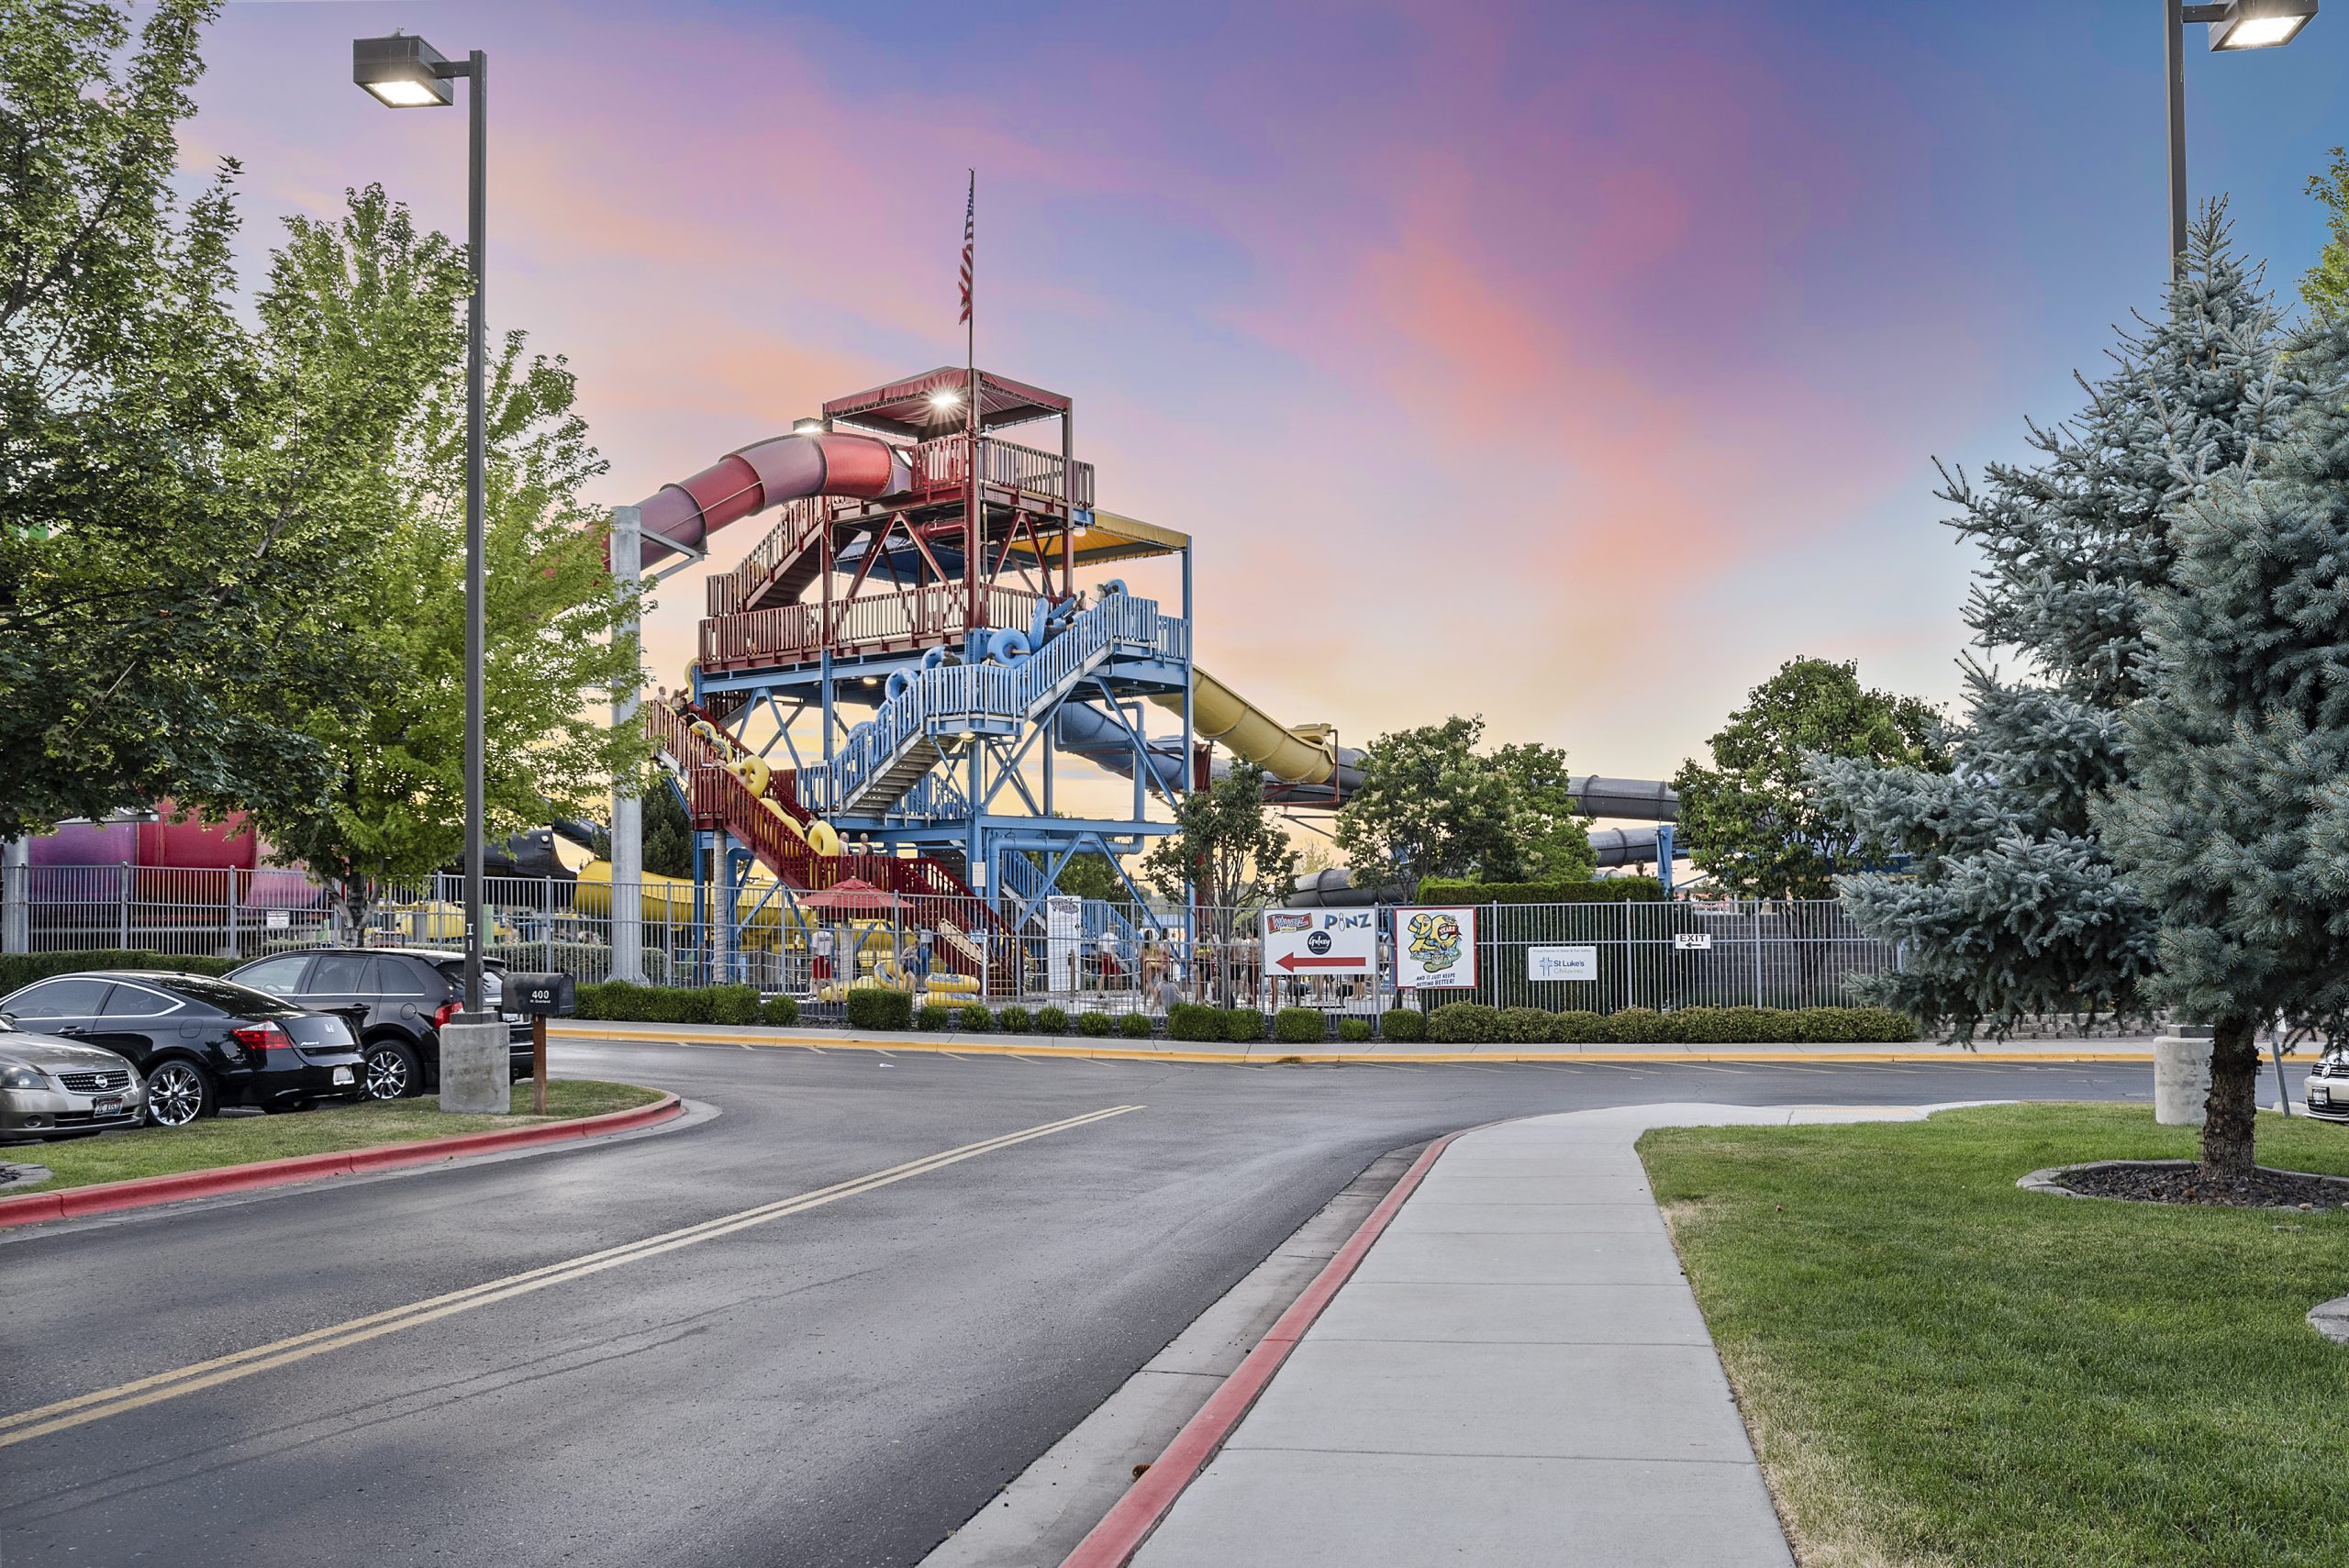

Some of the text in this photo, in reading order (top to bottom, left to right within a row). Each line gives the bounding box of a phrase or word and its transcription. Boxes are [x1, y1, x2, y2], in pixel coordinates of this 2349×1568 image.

[1438, 926, 1456, 935] YEARS
[1308, 935, 1330, 947] Galaxy
[1679, 934, 1707, 942] EXIT
[1434, 978, 1455, 986] BETTER!
[532, 990, 550, 999] 400
